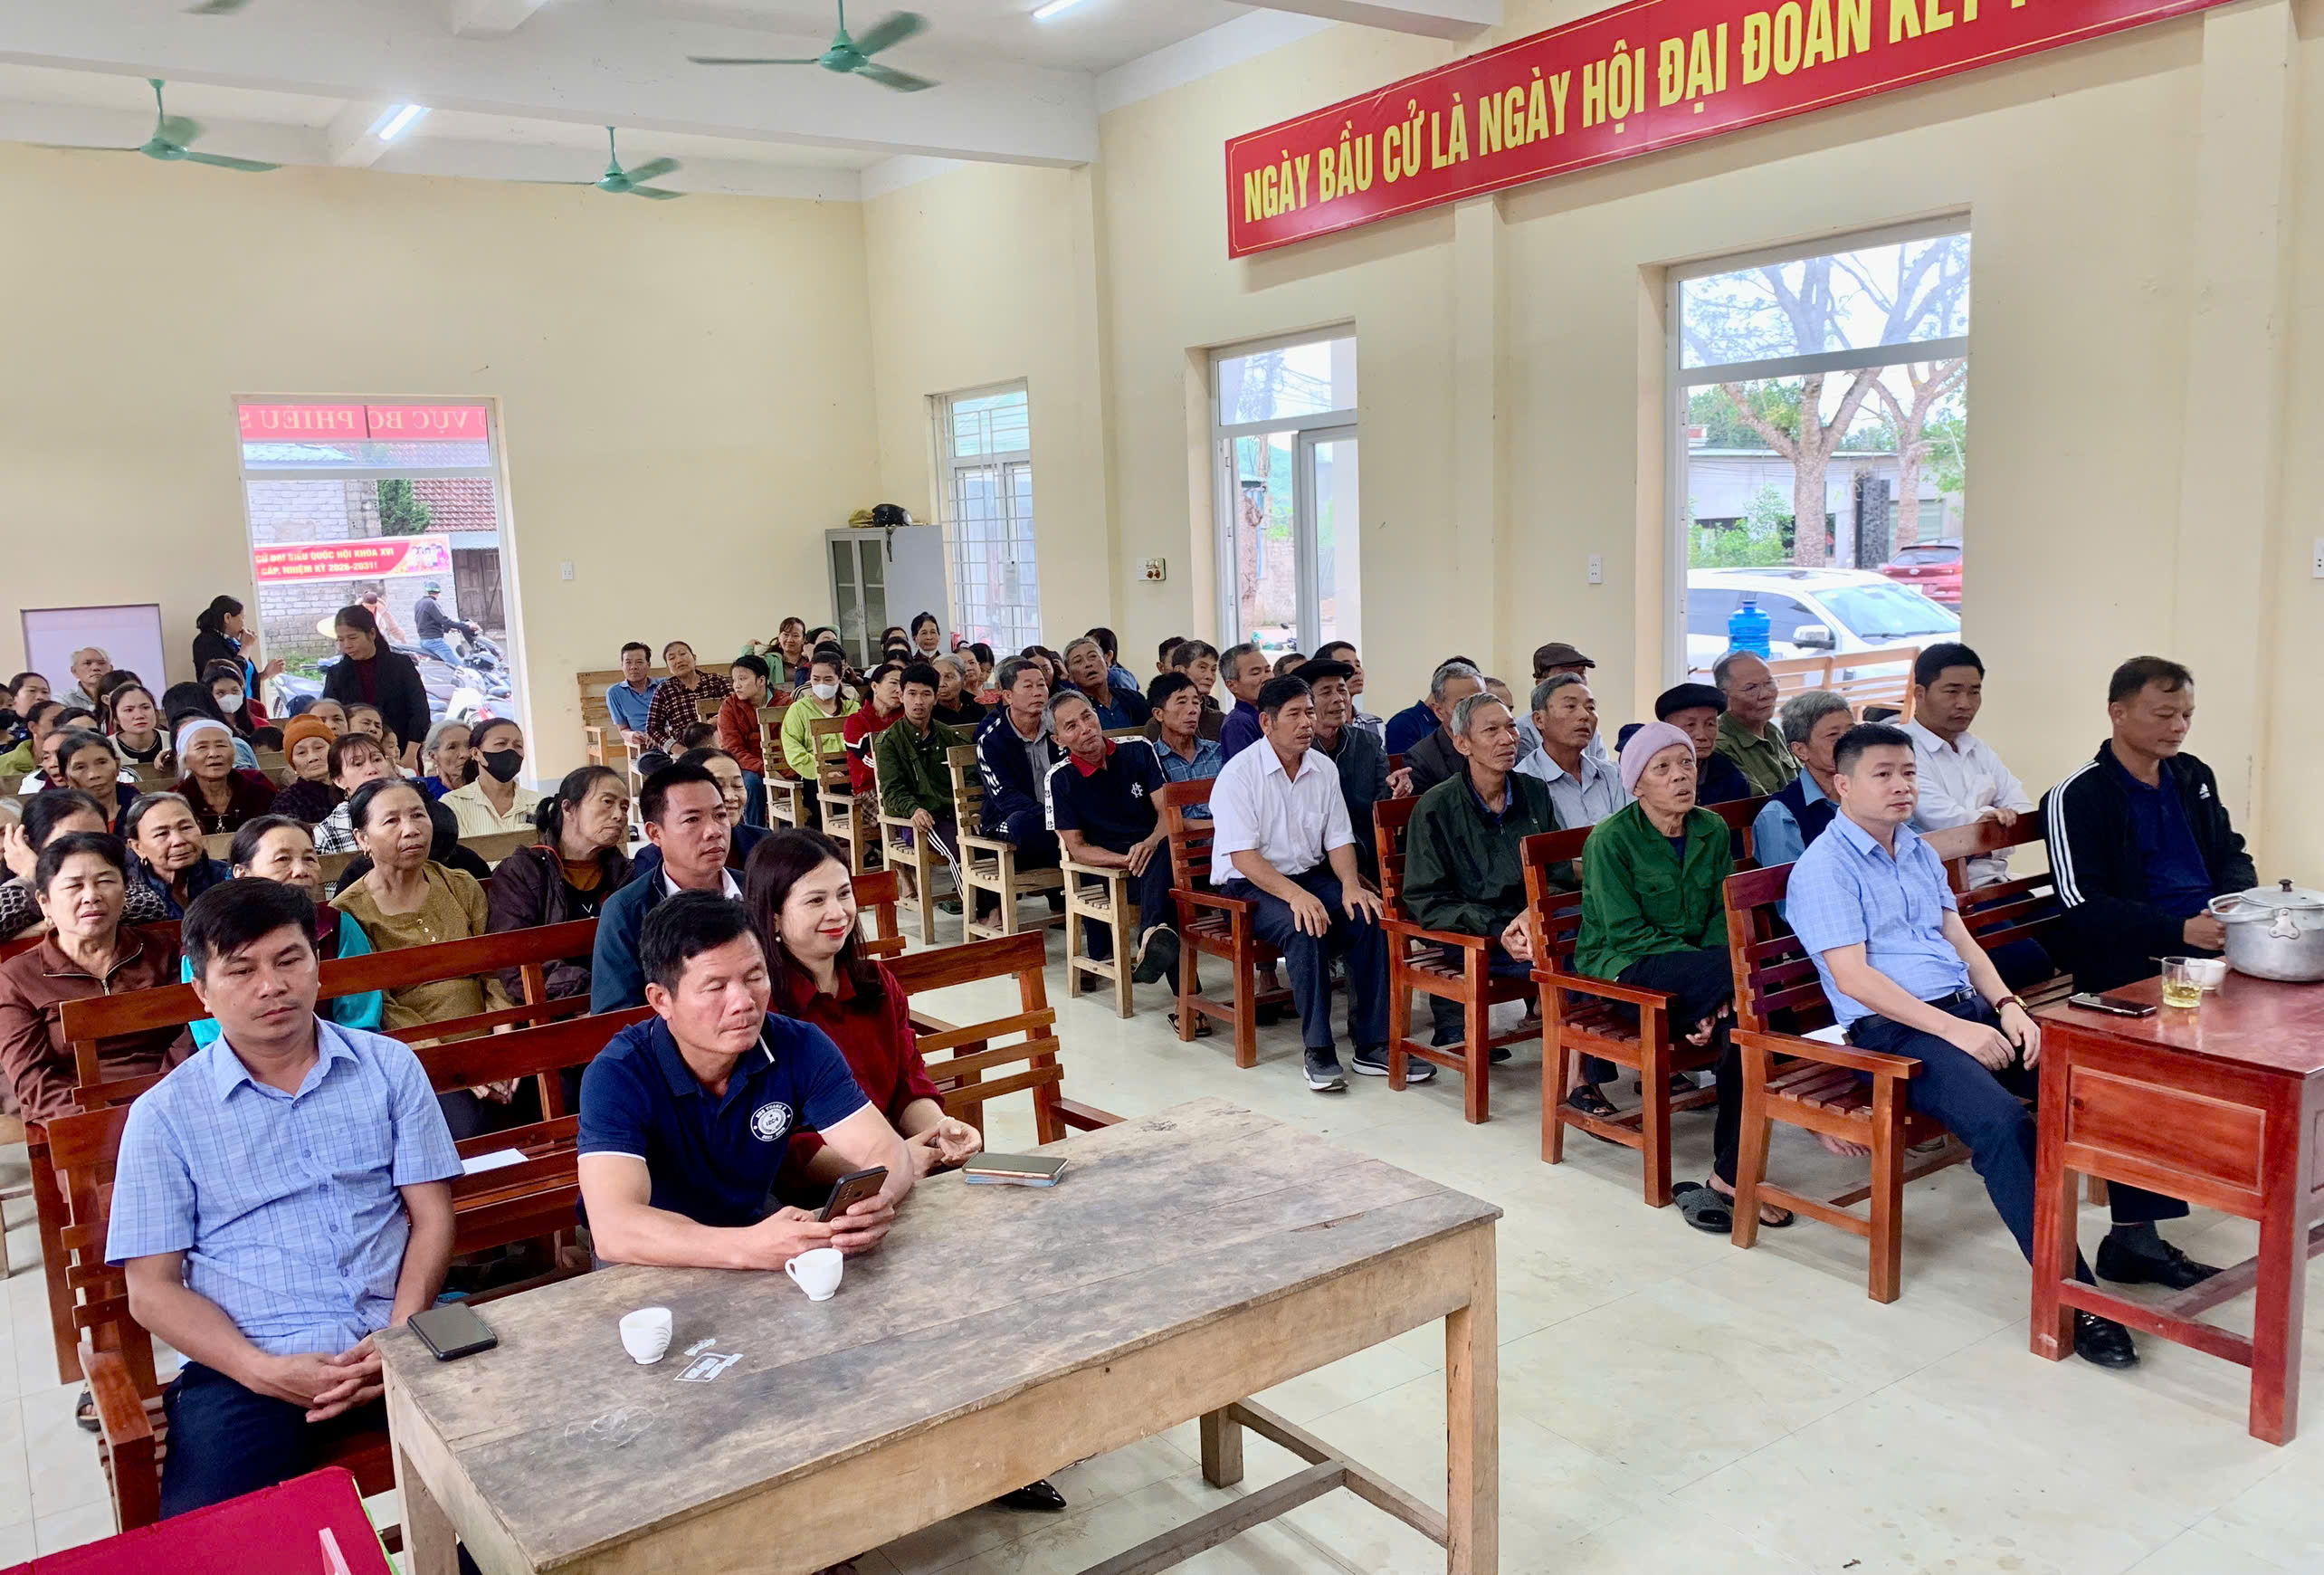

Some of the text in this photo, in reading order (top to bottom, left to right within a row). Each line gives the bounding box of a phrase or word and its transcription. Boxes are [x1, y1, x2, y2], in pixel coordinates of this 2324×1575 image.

[1244, 148, 1310, 223] NGÀY
[1319, 119, 1373, 204] BẦU
[1382, 99, 1426, 183] CỬ
[1431, 93, 1469, 169] LÀ
[1479, 66, 1571, 156] NGÀY
[1582, 39, 1645, 134] HỘI
[1657, 23, 1728, 114] ĐẠI
